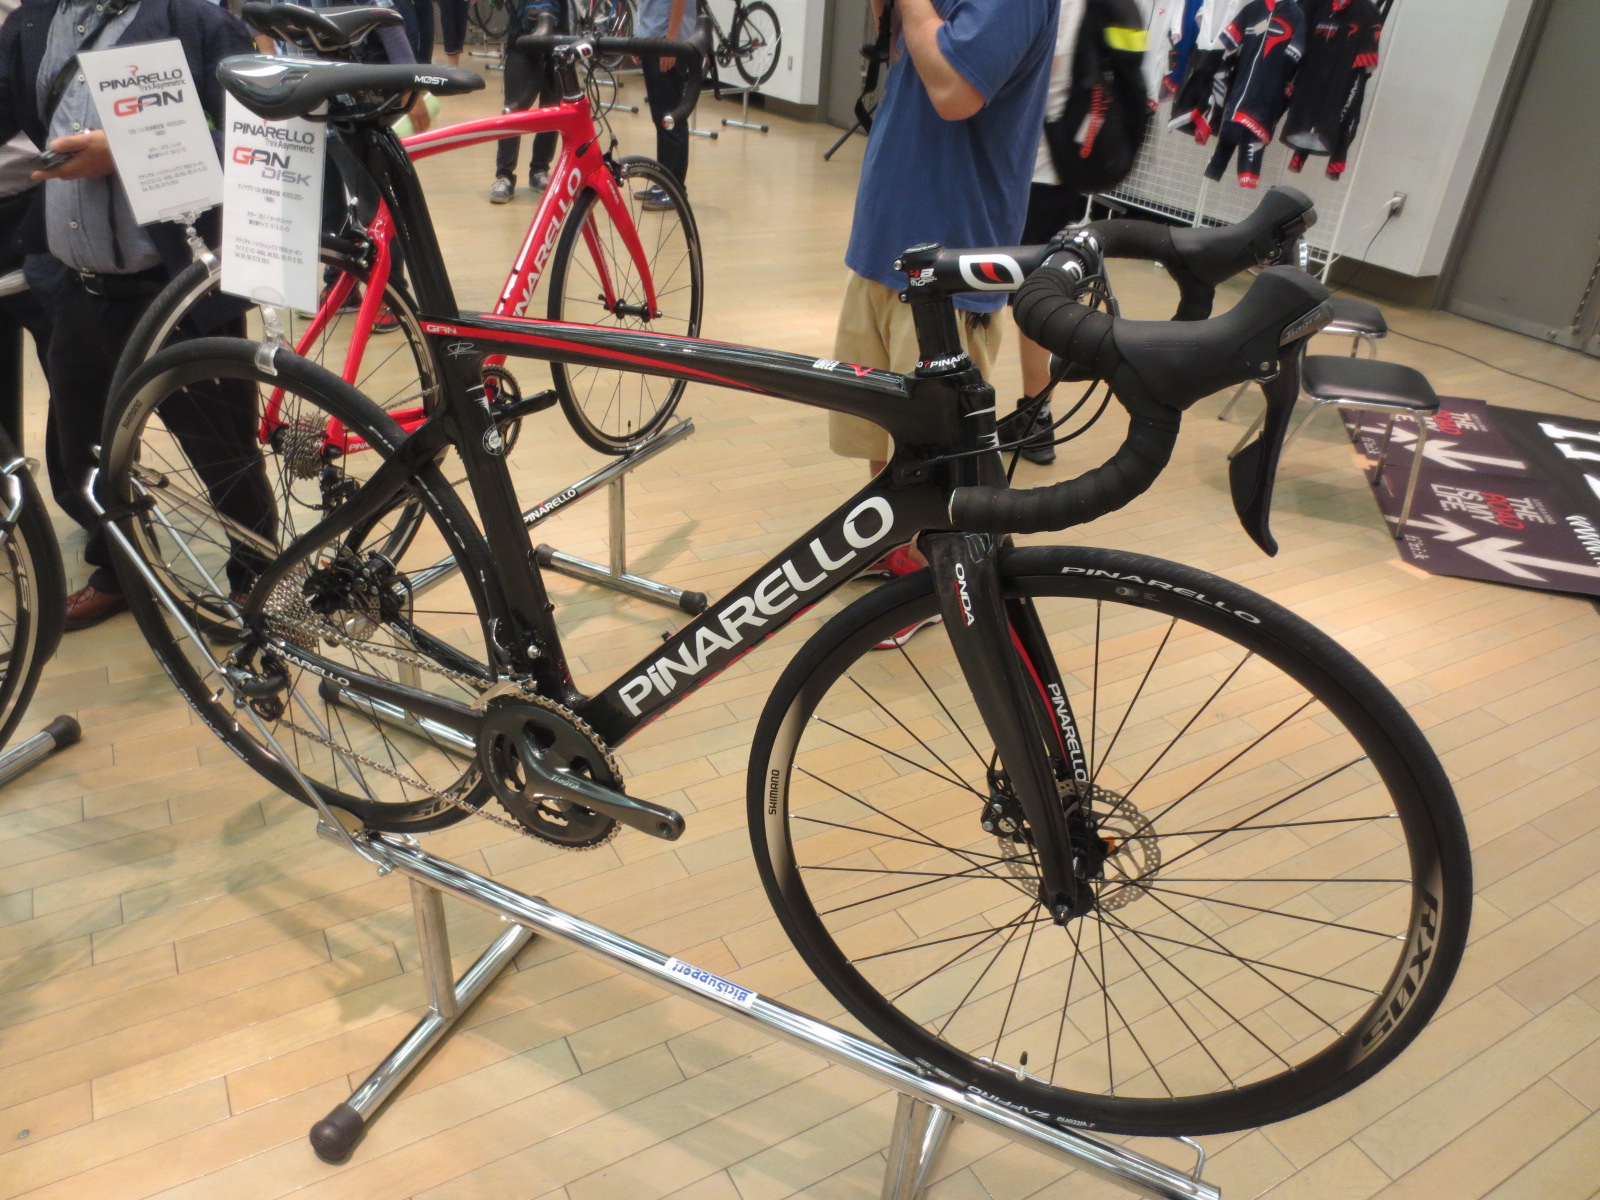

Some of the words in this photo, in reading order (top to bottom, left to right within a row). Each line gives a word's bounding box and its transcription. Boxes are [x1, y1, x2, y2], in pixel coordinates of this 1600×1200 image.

[99, 69, 183, 92] PINARELLO
[414, 75, 448, 86] MOST
[113, 89, 184, 117] GAN
[233, 121, 315, 145] PINARELLO
[232, 146, 291, 169] GAN
[261, 167, 312, 187] DISK
[512, 167, 582, 318] NARELLO
[426, 324, 458, 334] GAN
[122, 399, 142, 430] SHIMANO
[523, 489, 577, 523] PINARELLO
[1455, 487, 1483, 501] IS
[1464, 502, 1499, 525] MY
[1479, 492, 1525, 530] ROAD
[1507, 498, 1545, 524] THE
[618, 496, 894, 717] PINARELLO
[955, 562, 975, 626] ONDA
[1061, 566, 1261, 624] PINARELLO
[266, 642, 350, 687] PINARELLO
[1048, 682, 1090, 782] PINARELLO
[768, 769, 780, 816] SHIMANO
[672, 963, 748, 1002] BiciSupport
[967, 1085, 1050, 1120] ZAFFIRO
[1056, 1116, 1087, 1127] vittoria
